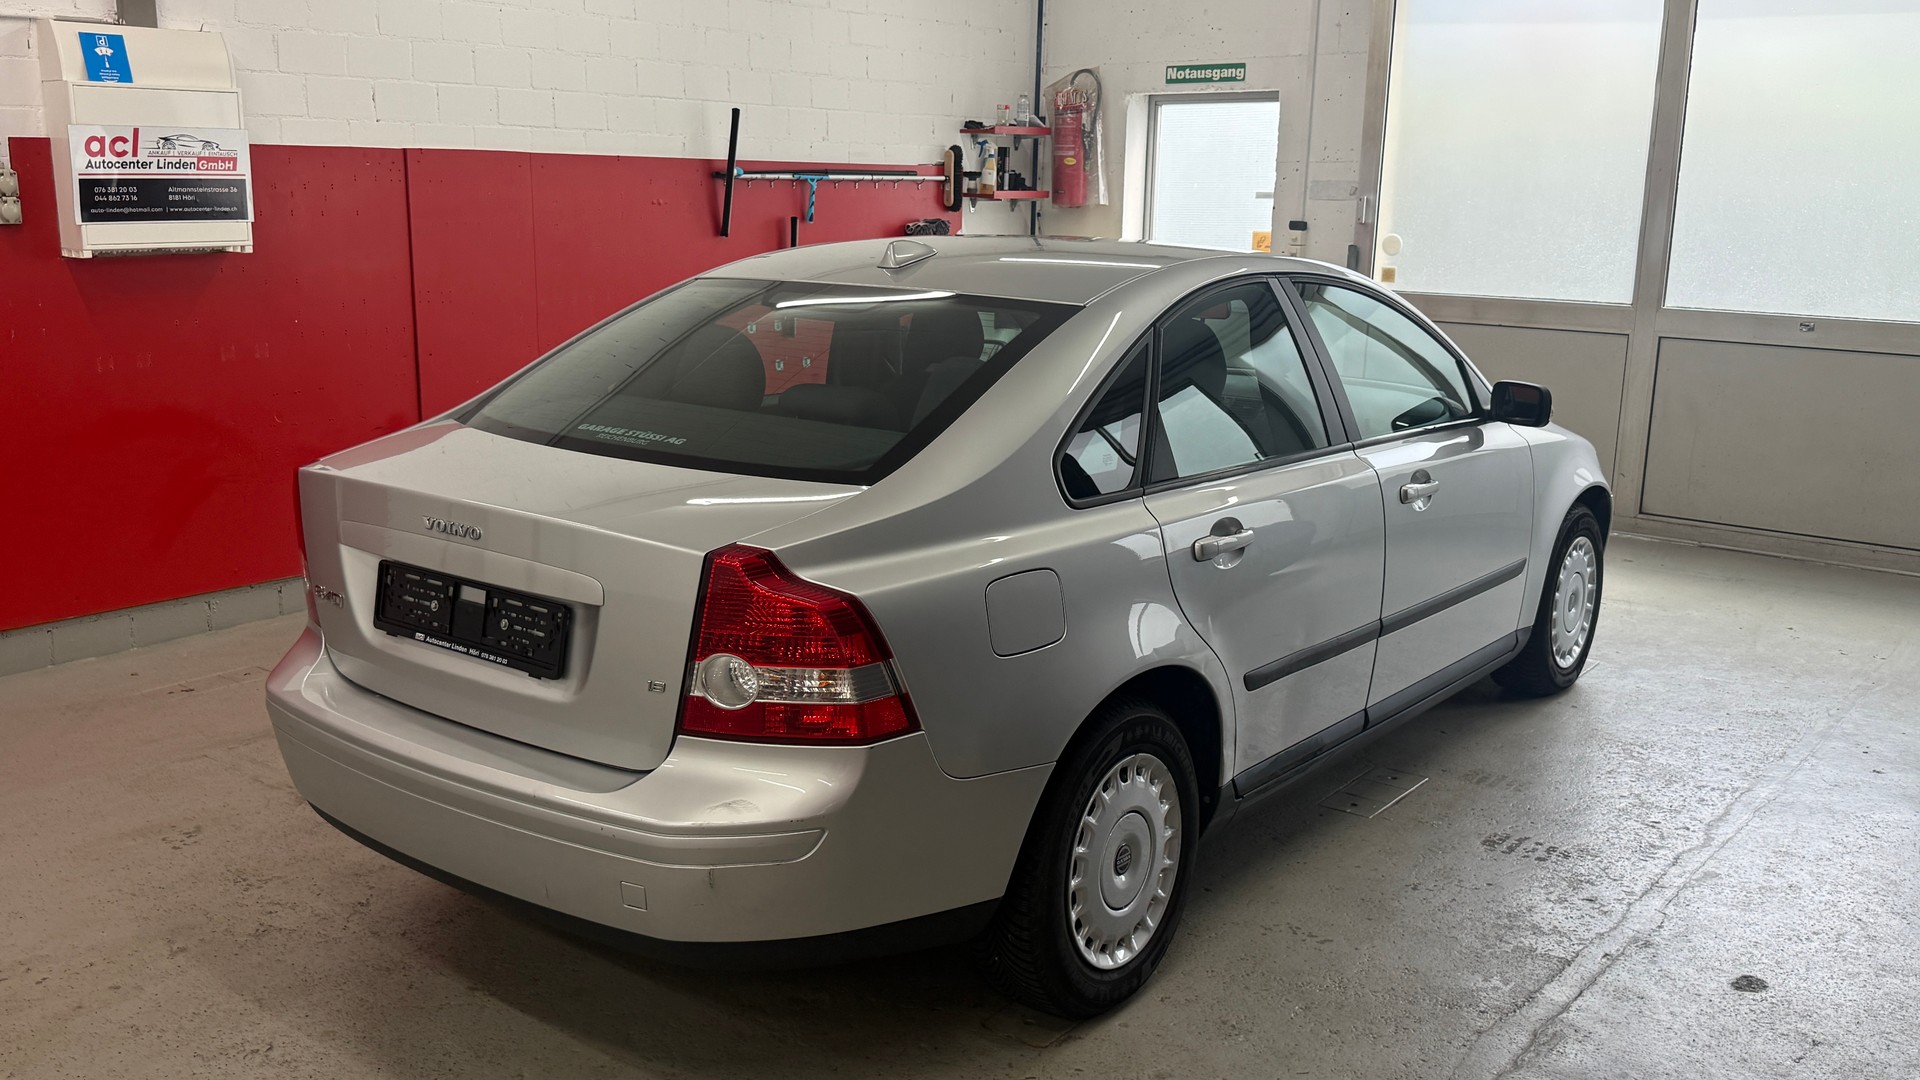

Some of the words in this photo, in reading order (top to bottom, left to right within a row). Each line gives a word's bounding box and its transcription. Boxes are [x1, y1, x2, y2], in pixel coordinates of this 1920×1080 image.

[1167, 68, 1245, 80] Notausgang
[84, 128, 140, 158] acl
[85, 159, 154, 170] Autocenter
[156, 158, 196, 170] Linden
[198, 160, 234, 171] GmbH
[578, 424, 628, 435] GARAGE
[625, 430, 666, 441] STÜSSI
[664, 436, 687, 445] AG
[423, 515, 482, 540] VOLVO
[426, 636, 451, 647] Autocenter
[451, 643, 467, 652] Linden
